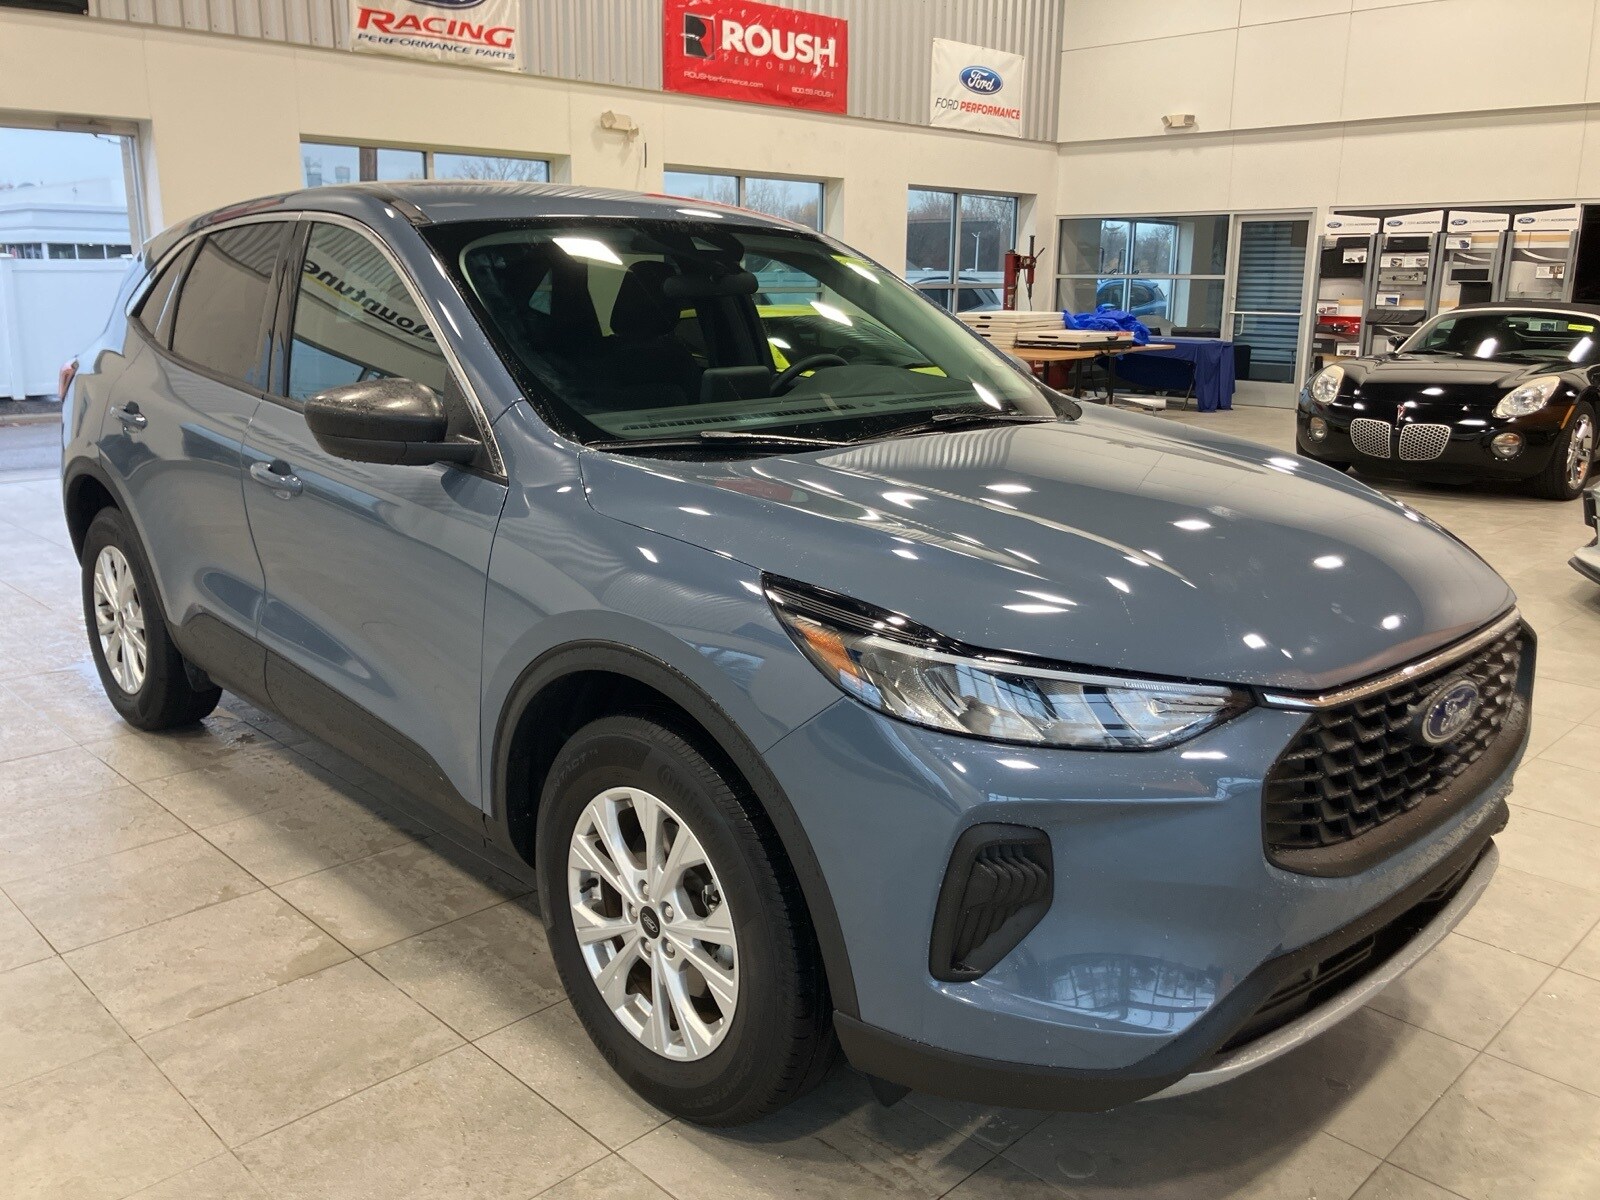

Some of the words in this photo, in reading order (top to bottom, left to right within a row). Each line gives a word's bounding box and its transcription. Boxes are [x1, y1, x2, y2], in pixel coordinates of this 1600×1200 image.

[357, 7, 515, 48] RACING
[357, 33, 471, 54] PERFORMANCE
[475, 49, 516, 60] PARTS
[721, 19, 837, 68] ROUSH
[723, 54, 835, 79] PERFORMANCE
[966, 68, 996, 92] Ford
[935, 97, 959, 111] FORD
[960, 101, 1020, 120] PERFORMANCE
